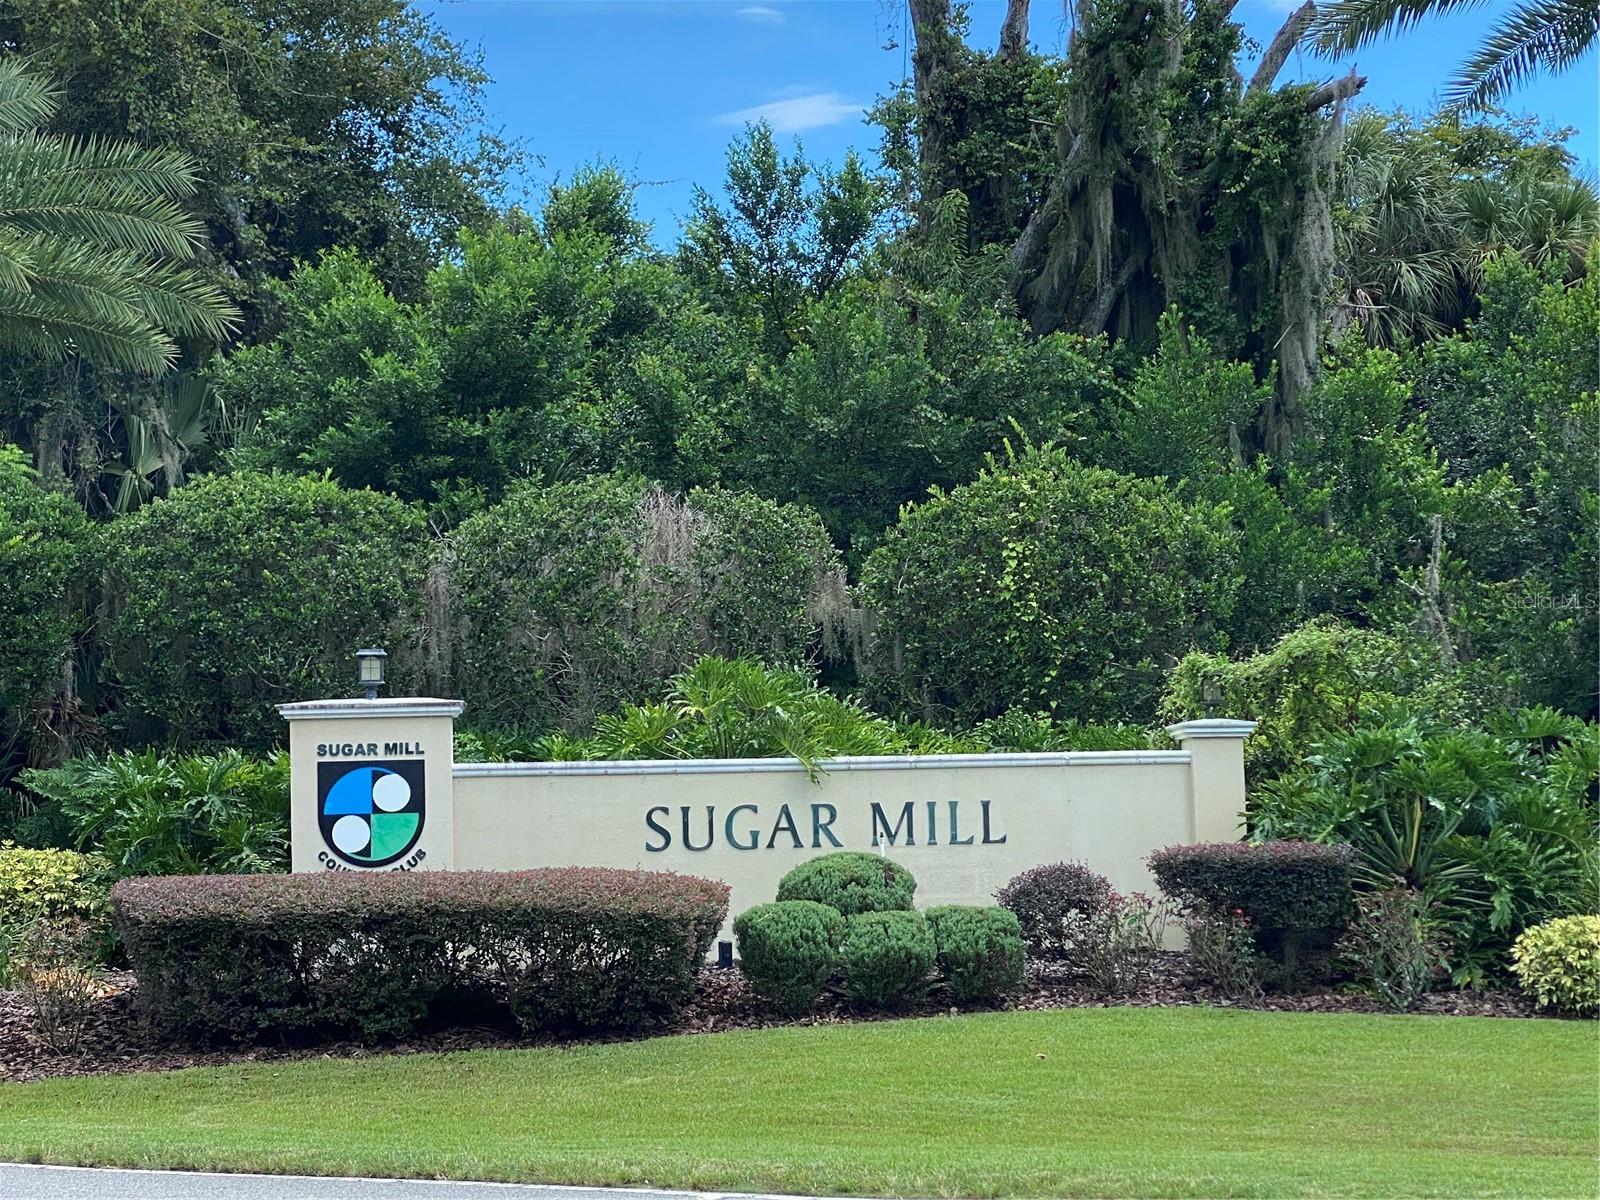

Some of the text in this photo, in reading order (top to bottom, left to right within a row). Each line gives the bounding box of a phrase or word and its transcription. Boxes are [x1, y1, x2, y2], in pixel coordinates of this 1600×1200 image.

[317, 742, 425, 757] SUGAR MILL
[645, 800, 1007, 852] SUGAR MILL
